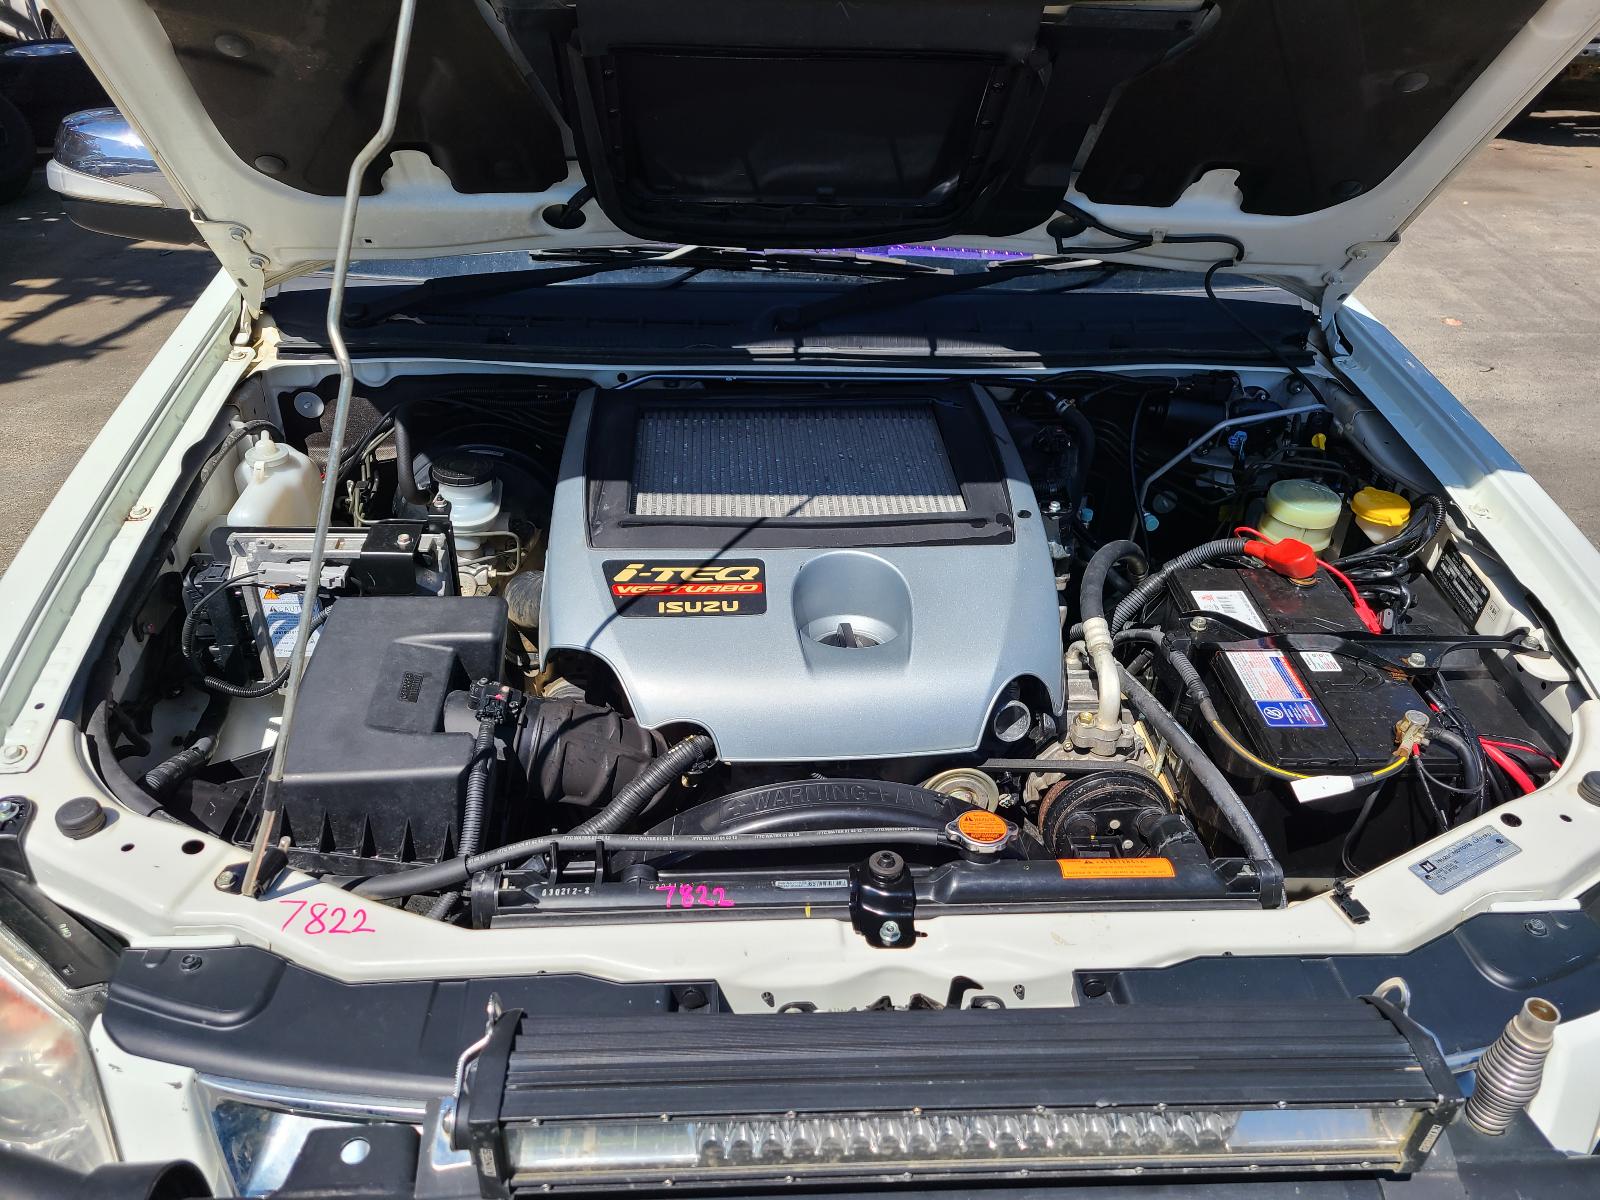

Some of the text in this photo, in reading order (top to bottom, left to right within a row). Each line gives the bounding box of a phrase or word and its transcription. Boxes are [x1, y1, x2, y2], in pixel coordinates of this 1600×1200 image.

[669, 584, 759, 593] TURBO
[658, 600, 739, 614] ISUZU
[655, 884, 736, 908] 7822
[279, 900, 376, 935] 7822
